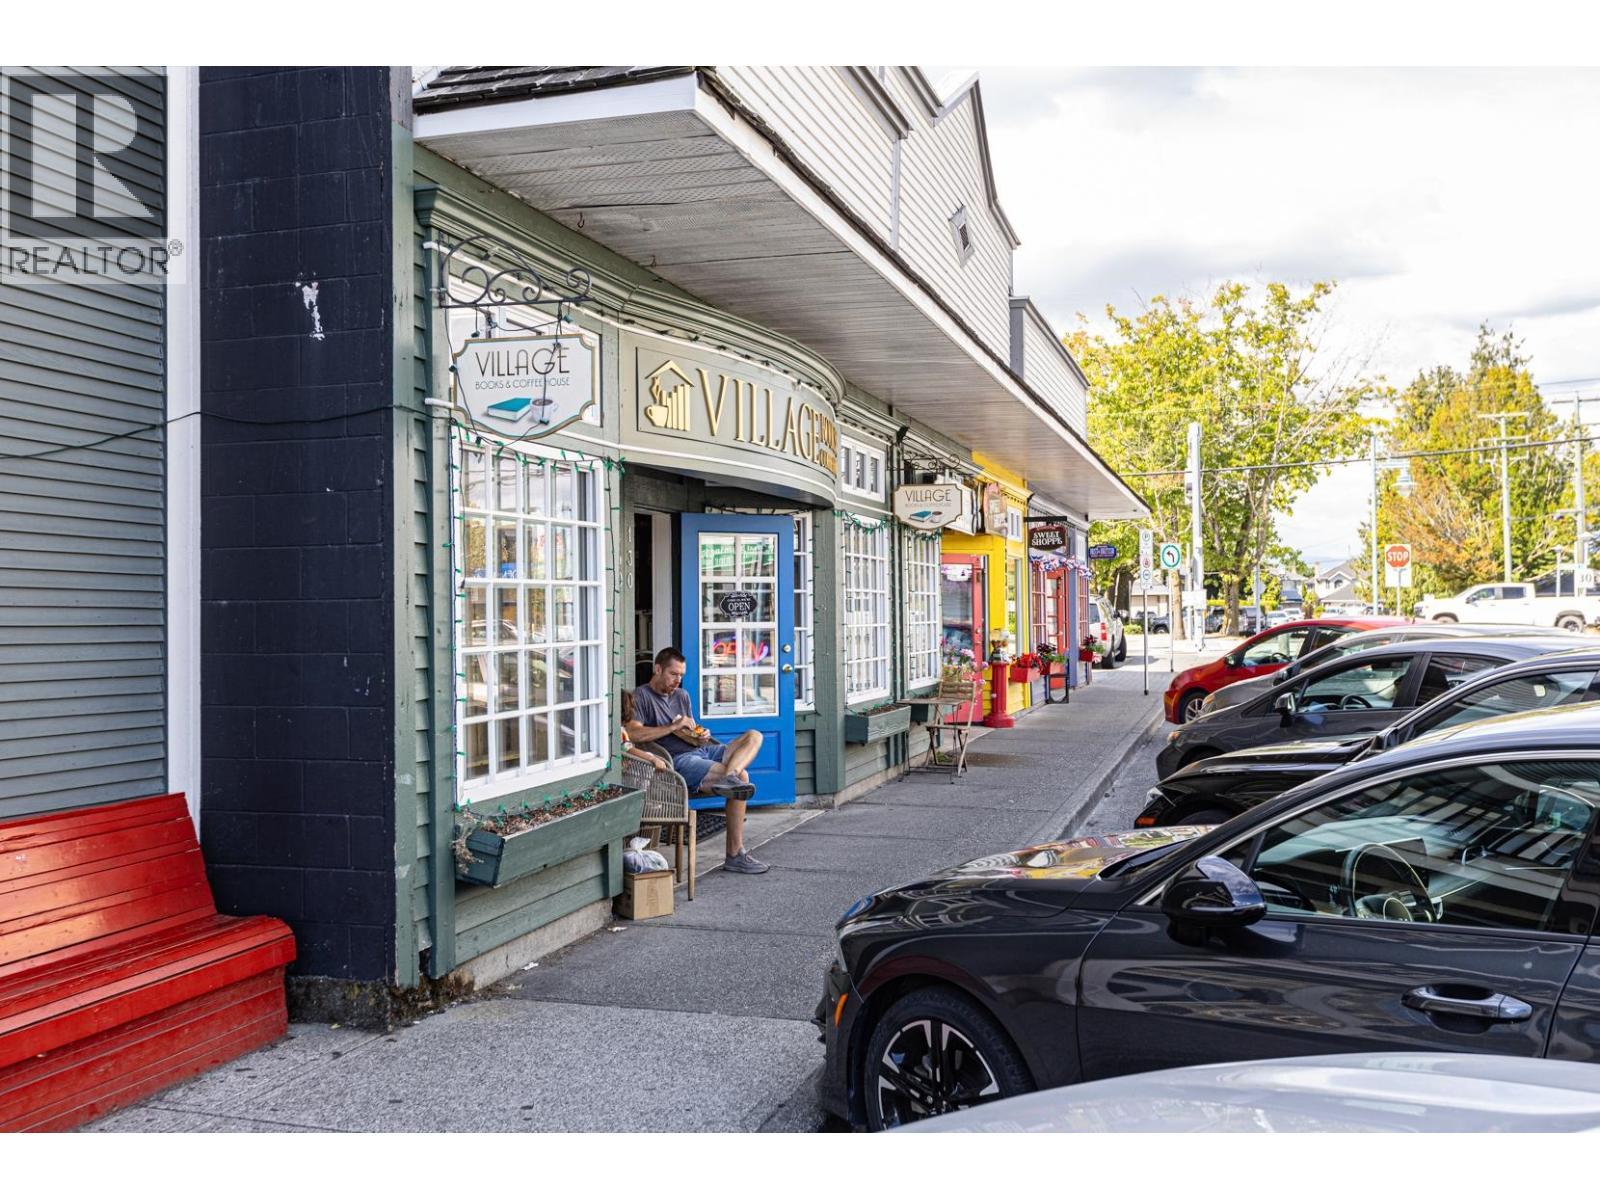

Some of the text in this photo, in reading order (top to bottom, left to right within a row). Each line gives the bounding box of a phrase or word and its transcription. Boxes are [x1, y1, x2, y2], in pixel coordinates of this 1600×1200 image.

[475, 346, 570, 377] VILLAGE
[475, 380, 504, 390] BOOKS
[506, 380, 511, 388] &
[513, 378, 543, 388] COFFEE
[696, 367, 819, 466] VILLAGE
[905, 489, 951, 502] VILLAGE
[1033, 531, 1059, 539] SWEET
[1031, 537, 1063, 546] SHOPPE
[1387, 550, 1409, 561] STOP
[728, 601, 751, 612] OPEN
[712, 640, 764, 662] OPN
